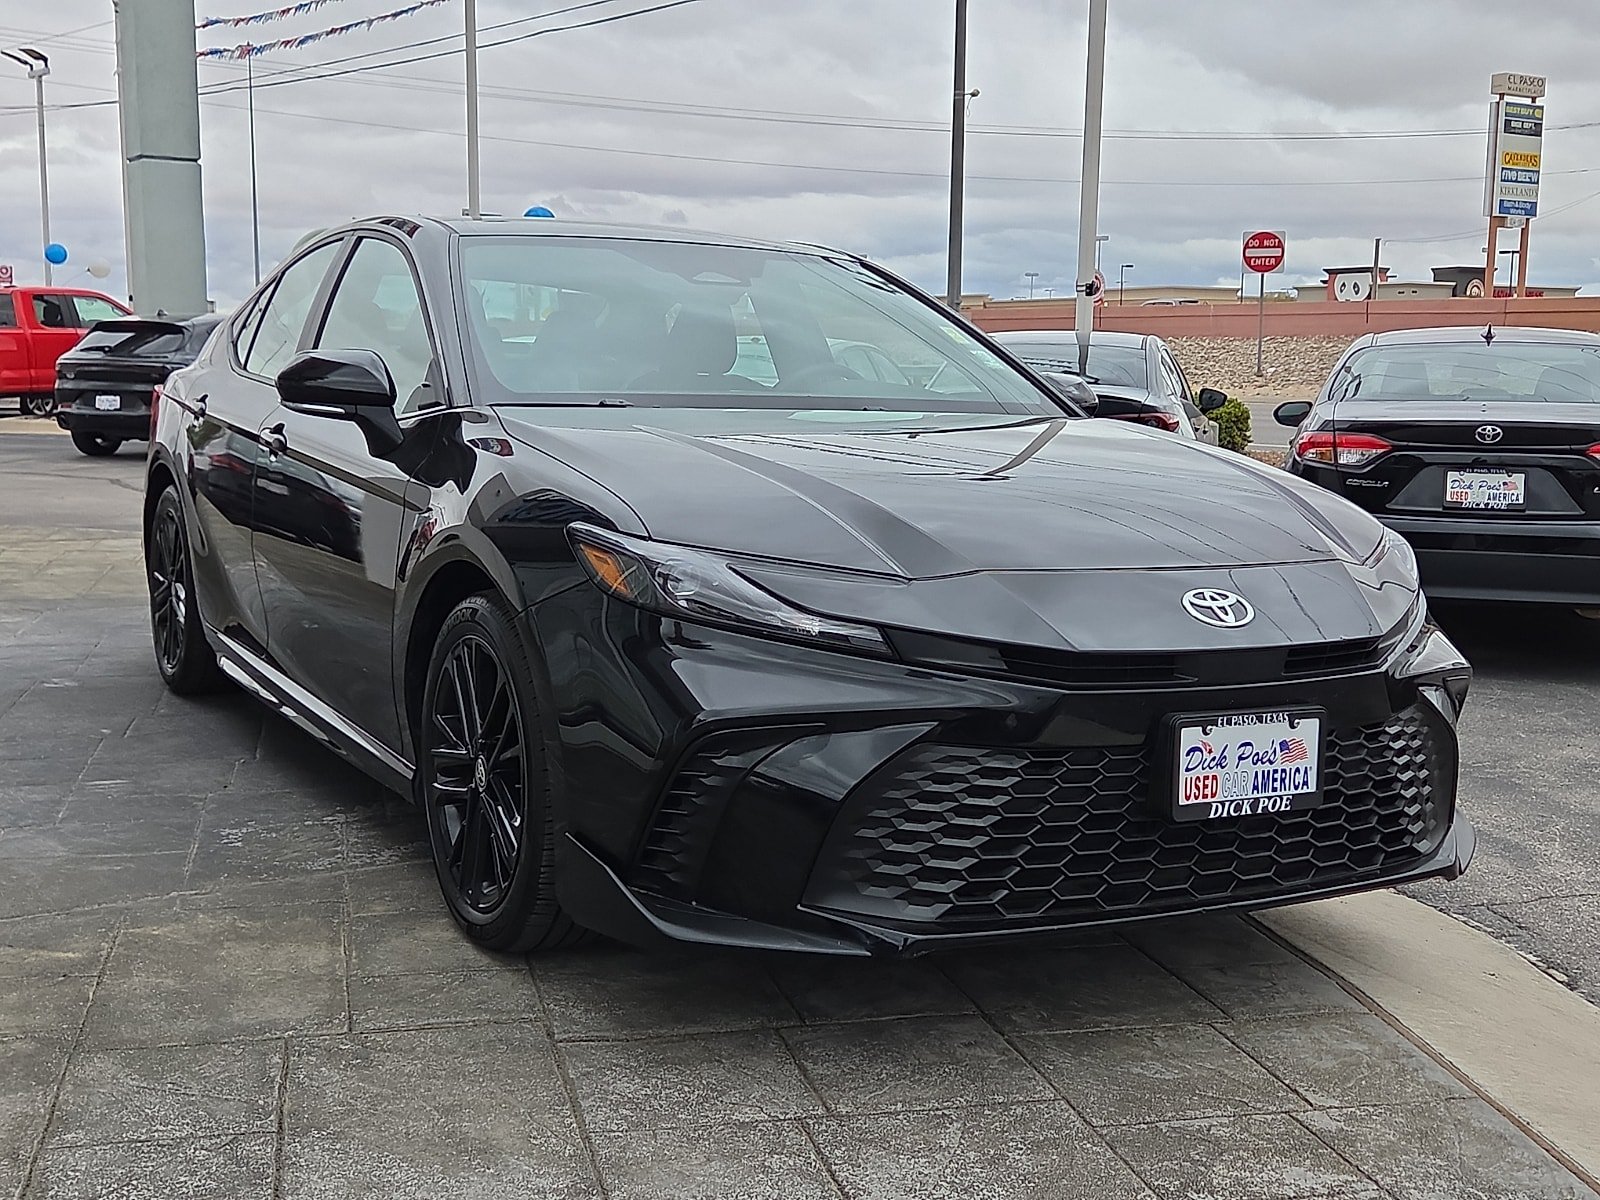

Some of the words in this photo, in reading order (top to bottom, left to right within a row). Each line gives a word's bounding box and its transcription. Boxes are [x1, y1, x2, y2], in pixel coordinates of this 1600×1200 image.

[1508, 74, 1518, 84] EL
[1519, 76, 1544, 88] PASEO
[1248, 239, 1260, 247] DO
[1263, 238, 1279, 247] NOT
[1250, 257, 1276, 266] ENTER
[1450, 479, 1474, 490] Dick
[1478, 479, 1501, 491] Poe's
[1450, 491, 1469, 501] USED
[1486, 492, 1520, 503] AMERICA
[1217, 716, 1227, 727] EL
[1262, 712, 1289, 724] TEXAS
[1184, 743, 1229, 773] Dick
[1236, 738, 1278, 769] Poe's
[1184, 774, 1219, 801] USED
[1221, 771, 1249, 798] CAR
[1251, 766, 1310, 795] AMERICA
[1208, 799, 1254, 819] DICK
[1256, 795, 1293, 814] POE
